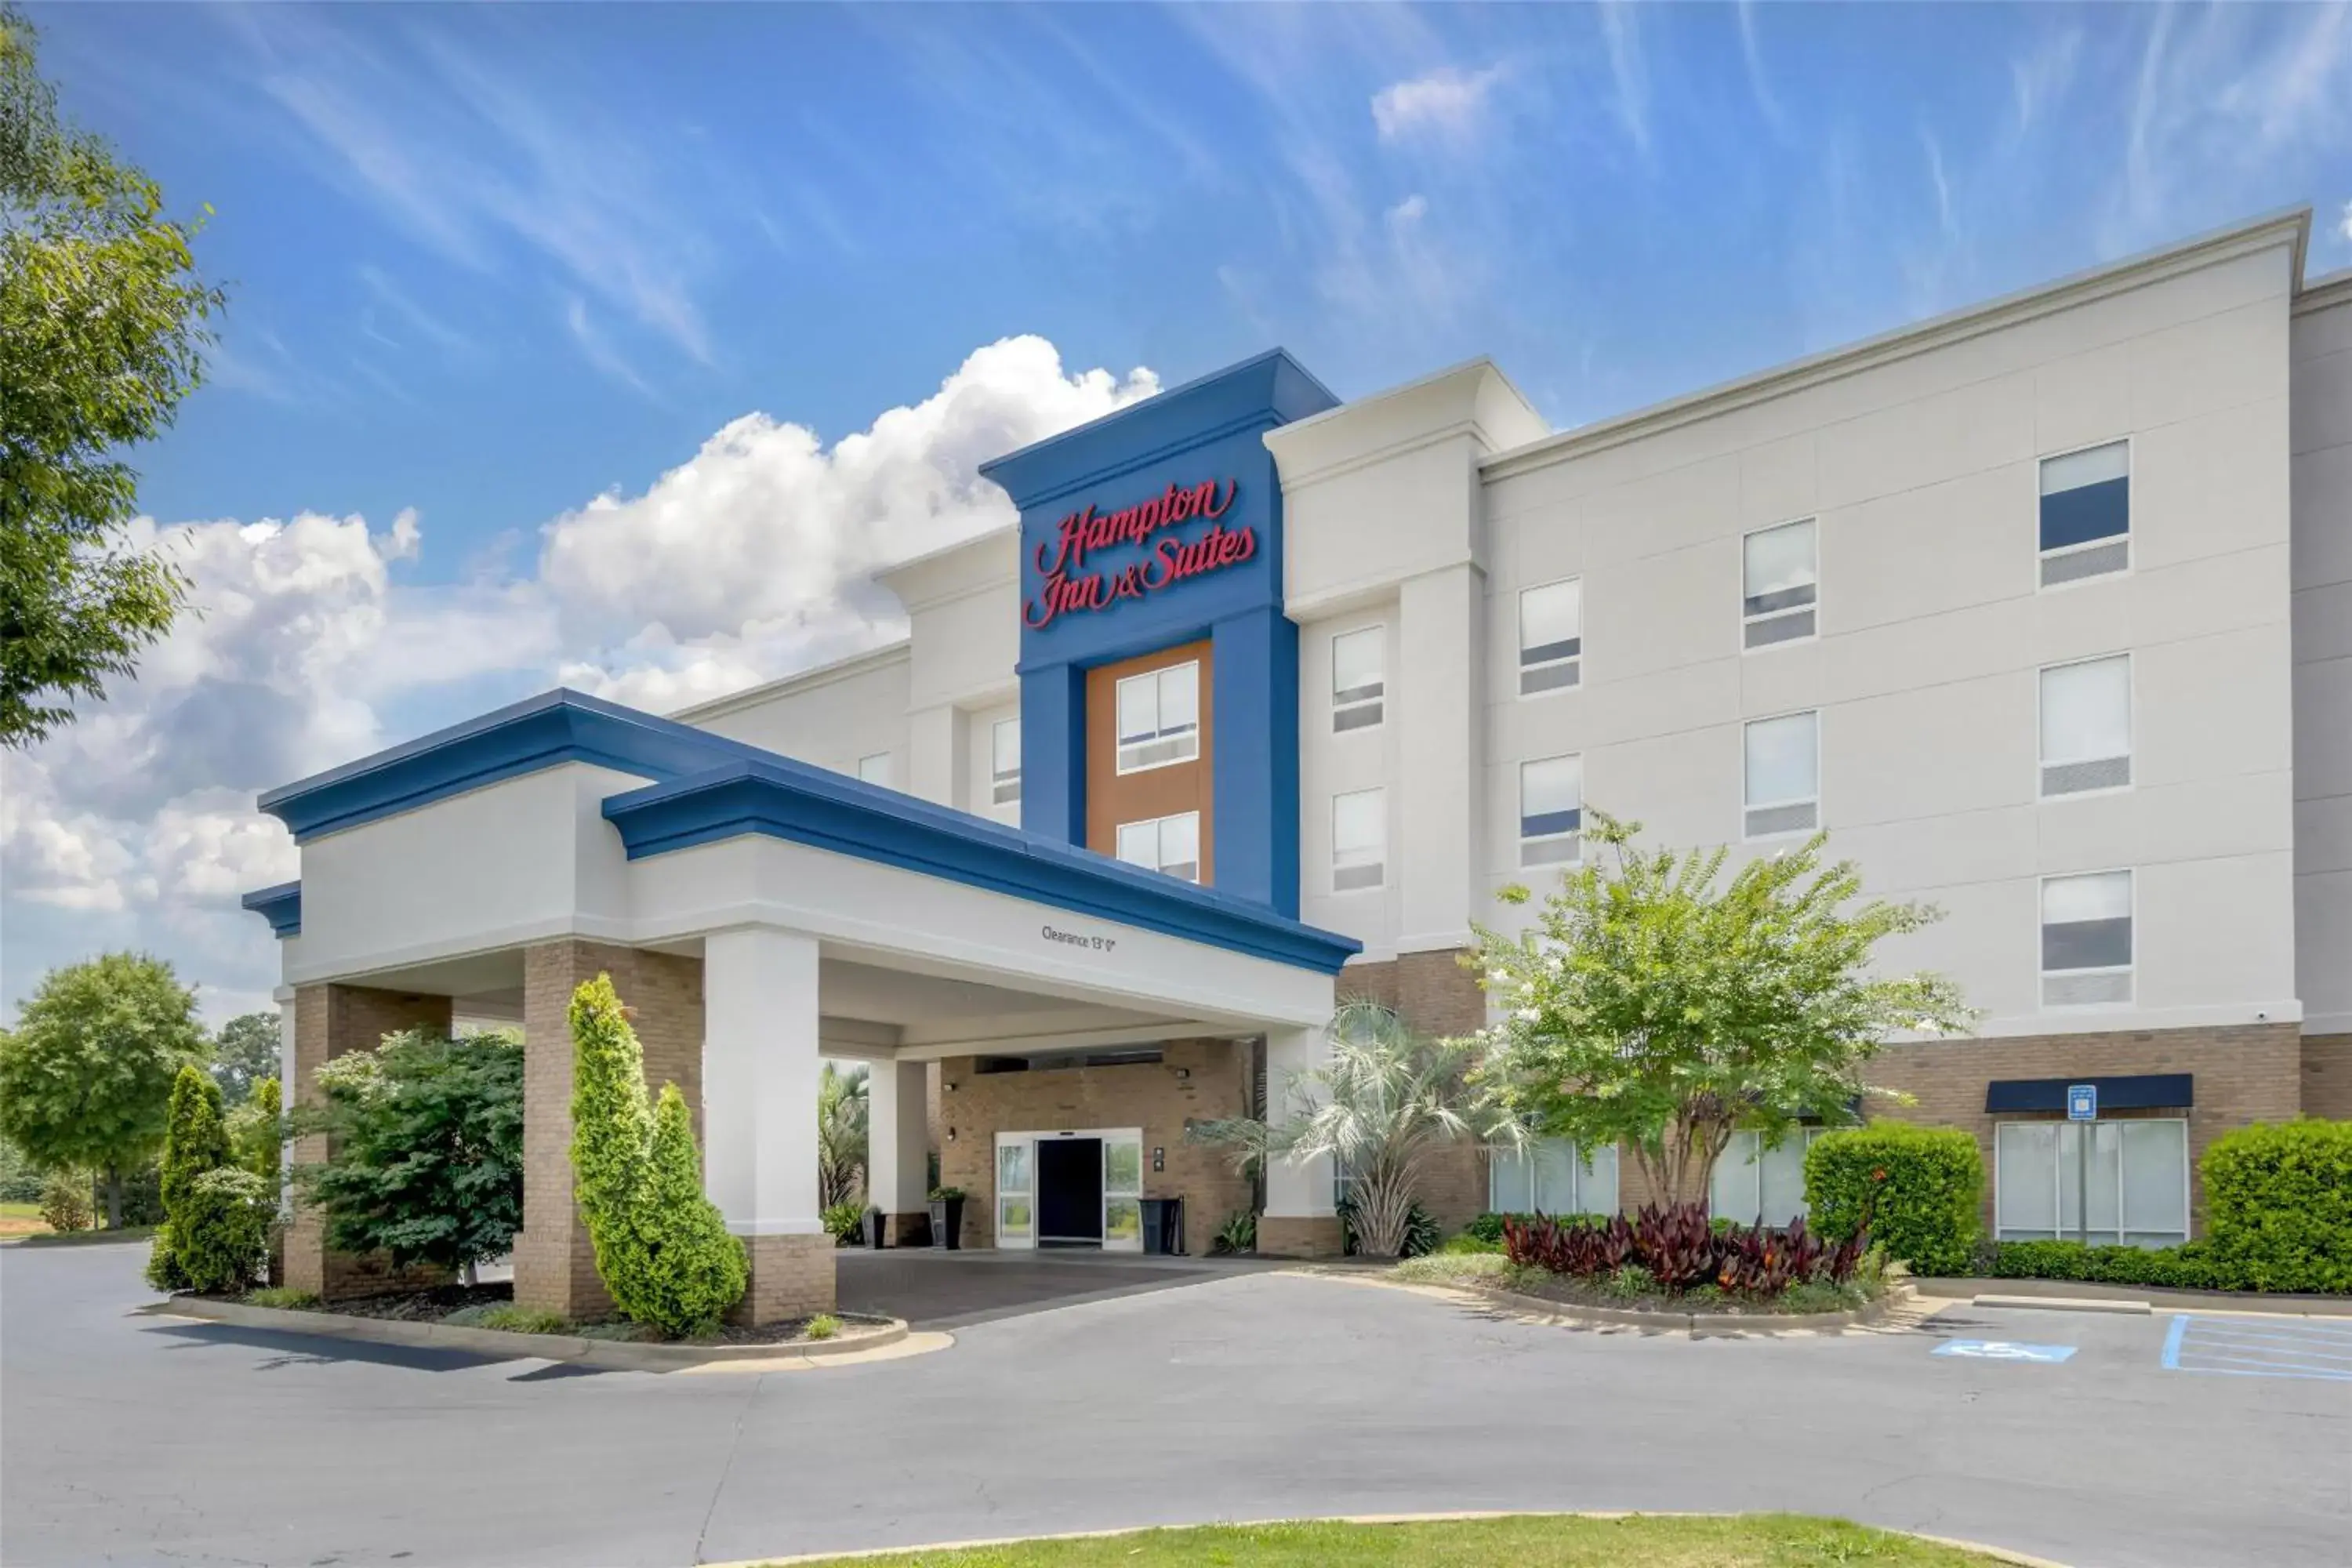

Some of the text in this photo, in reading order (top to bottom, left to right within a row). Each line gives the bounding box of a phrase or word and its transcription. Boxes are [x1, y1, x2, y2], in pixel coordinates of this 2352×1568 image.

[1034, 477, 1238, 576] Hampton
[1022, 524, 1256, 629] Inn & Suites
[1042, 925, 1089, 948] Clearance
